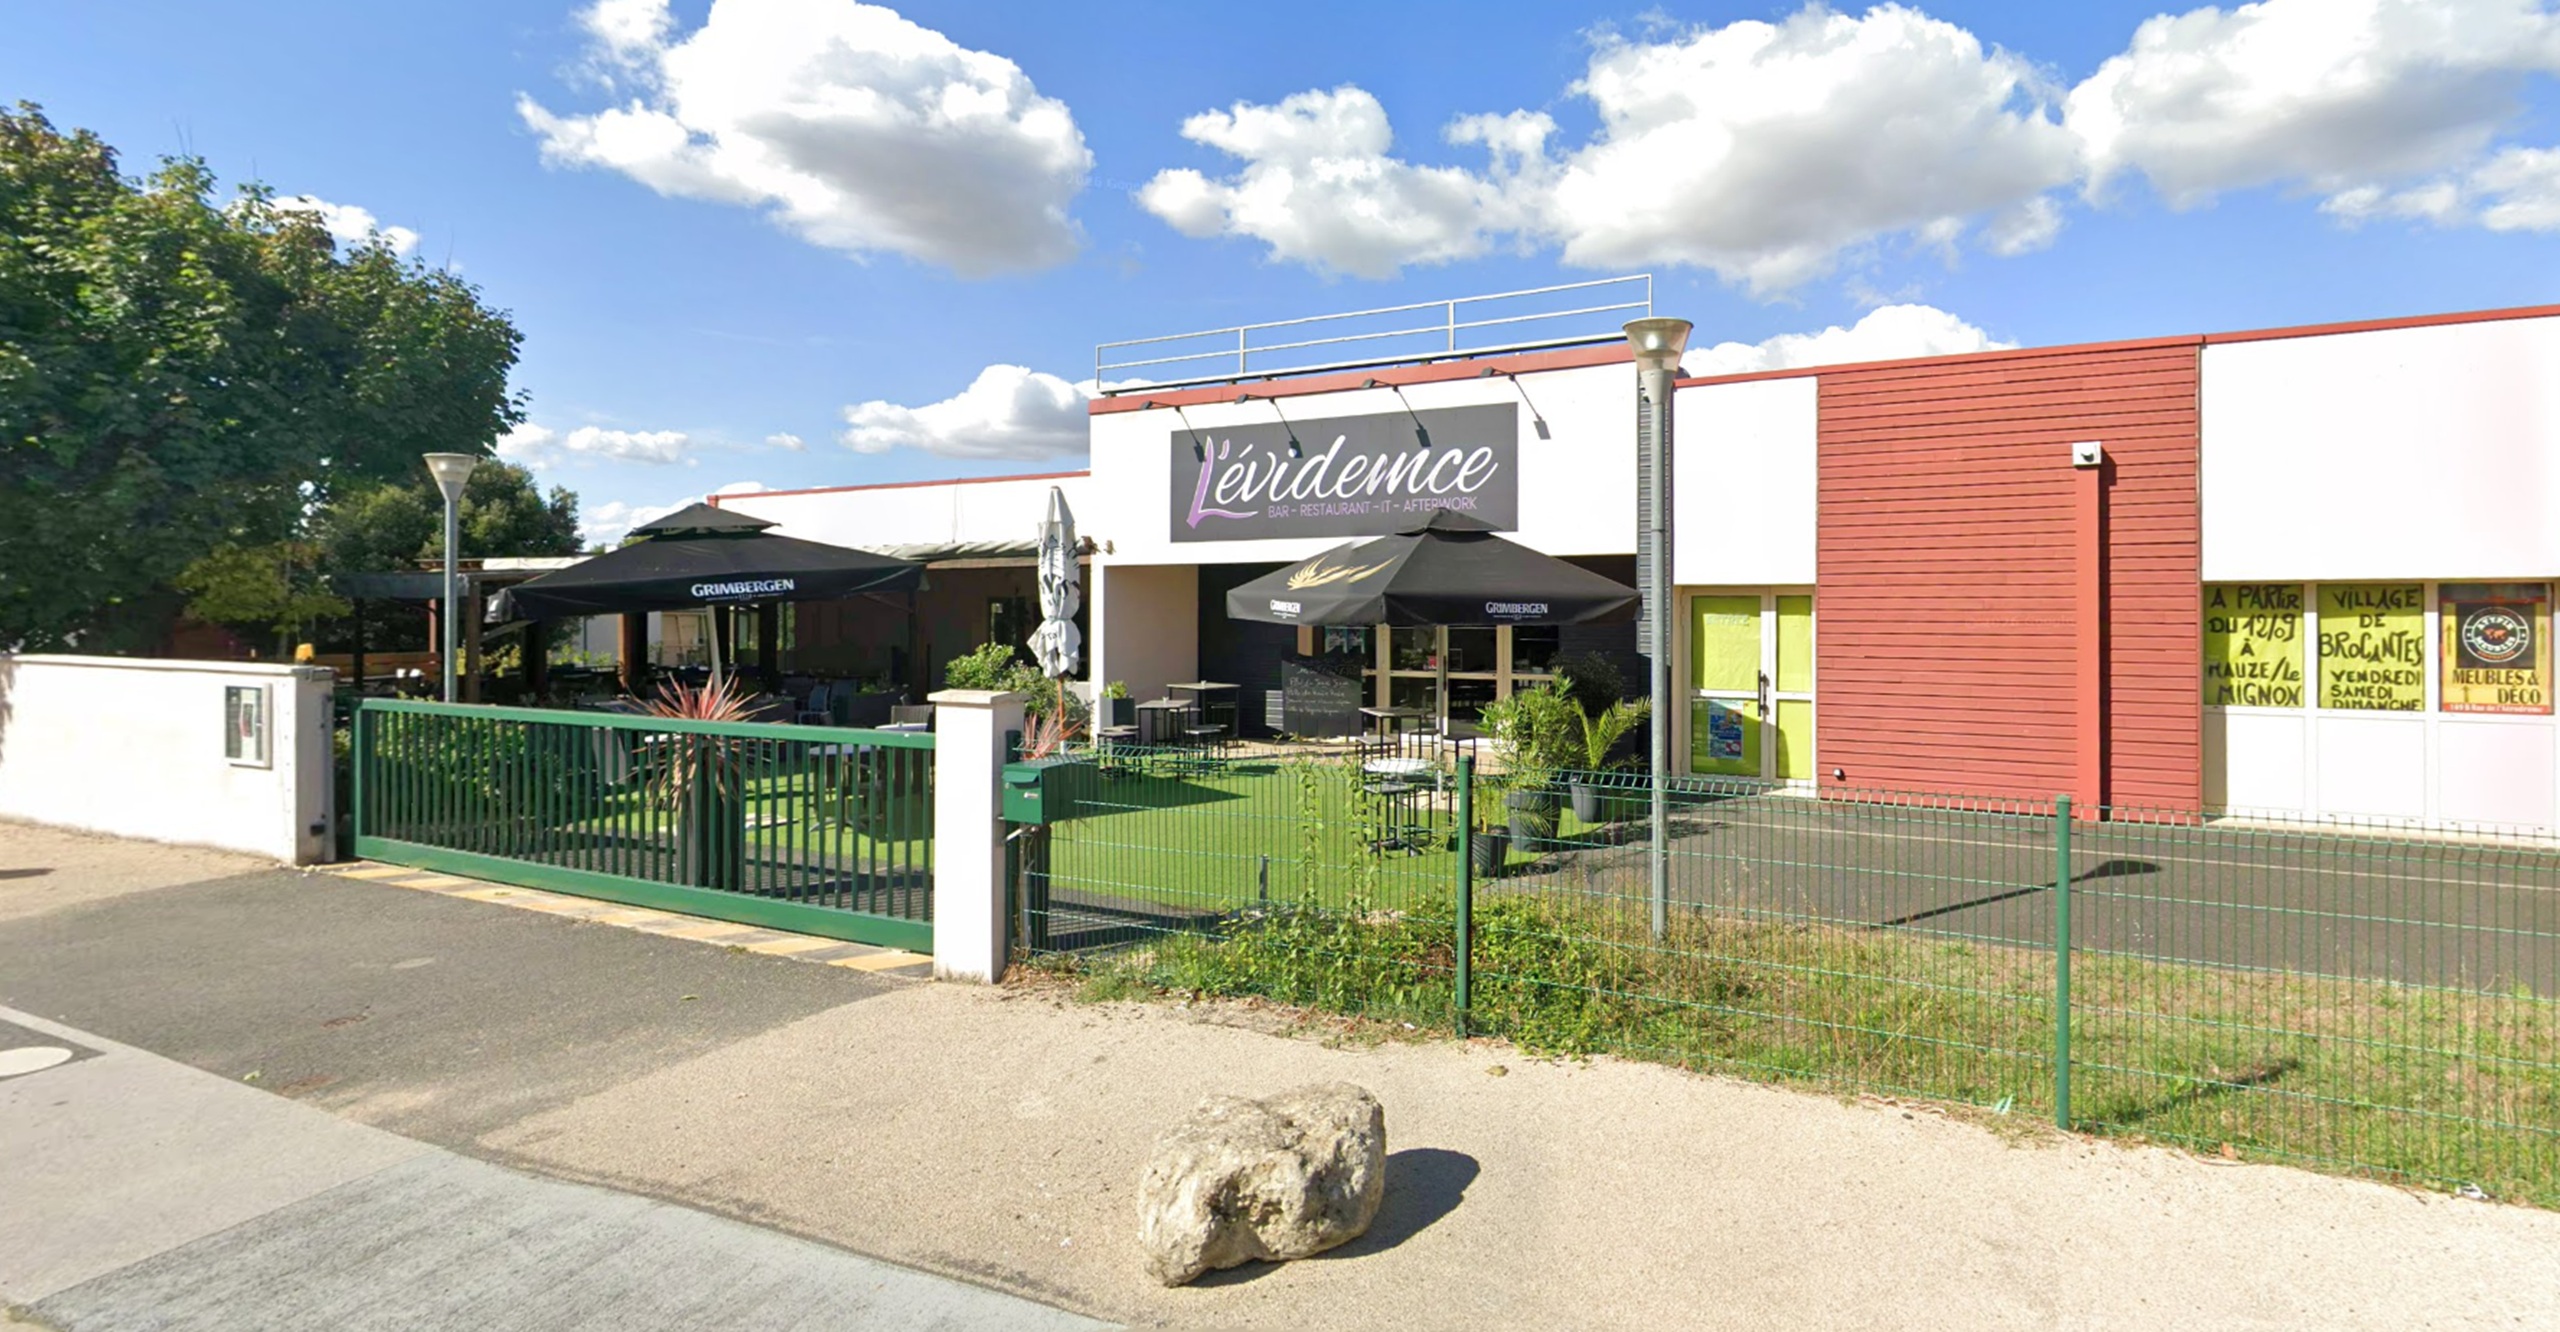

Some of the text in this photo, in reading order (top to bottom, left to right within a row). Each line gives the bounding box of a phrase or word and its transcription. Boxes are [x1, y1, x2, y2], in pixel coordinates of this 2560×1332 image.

[1268, 506, 1289, 518] BAR
[1300, 502, 1370, 517] RESTAURANT
[1381, 501, 1391, 513] IT
[1403, 496, 1477, 513] AFTERWORK
[691, 579, 795, 597] GRIMBERGEN
[2333, 588, 2419, 610] VILLAGE
[1485, 601, 1548, 614] GRIMBERGEN
[2208, 613, 2295, 642] DU 12/09
[2360, 613, 2386, 628] DE
[2330, 669, 2421, 686] VENDREDI
[2453, 669, 2540, 685] MEUBLES &
[2330, 685, 2393, 700] SAMEDI
[2332, 699, 2421, 711] DIMANCHE
